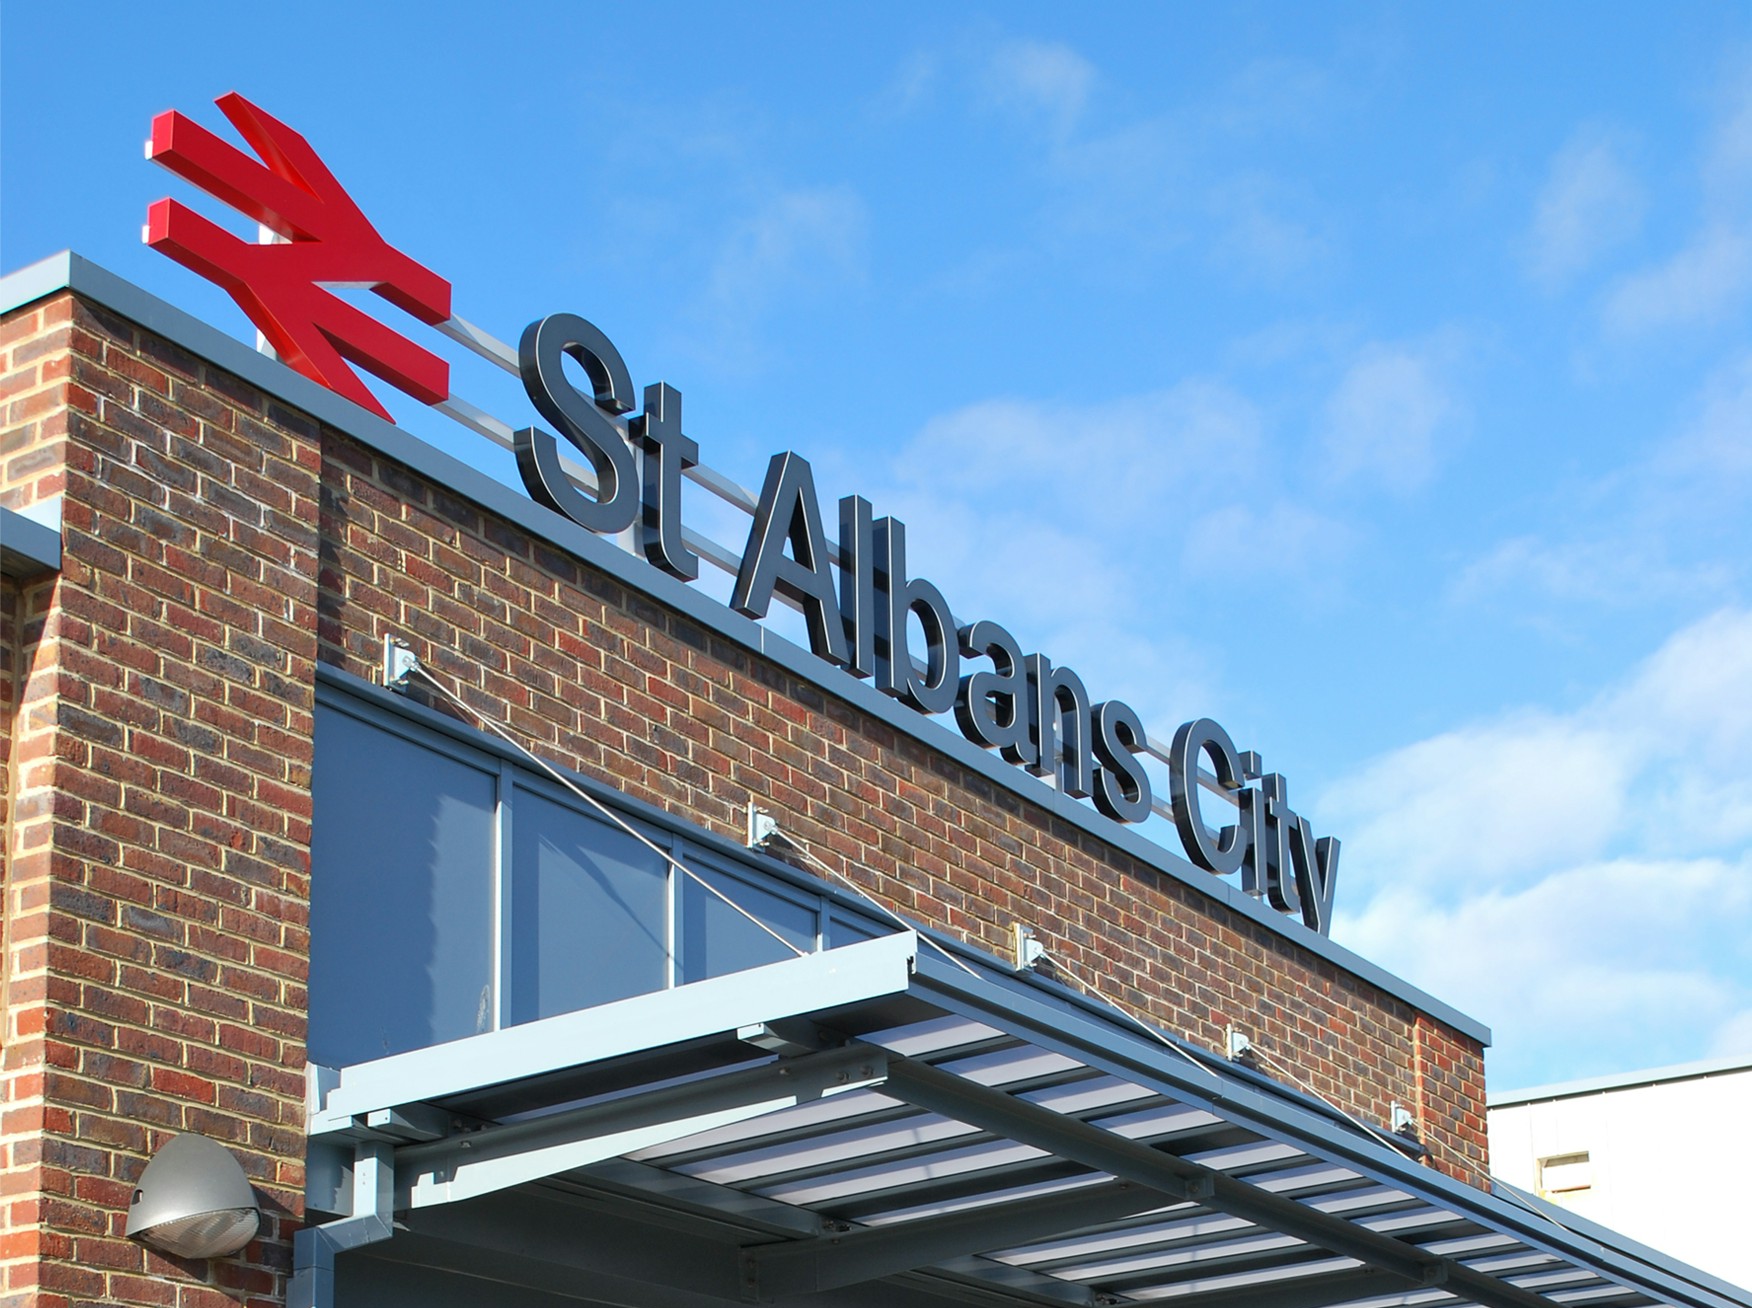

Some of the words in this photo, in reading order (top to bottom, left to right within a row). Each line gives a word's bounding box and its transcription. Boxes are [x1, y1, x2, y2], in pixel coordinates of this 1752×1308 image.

[514, 312, 699, 582] St
[729, 449, 1152, 824] Albans
[1169, 717, 1341, 937] City
